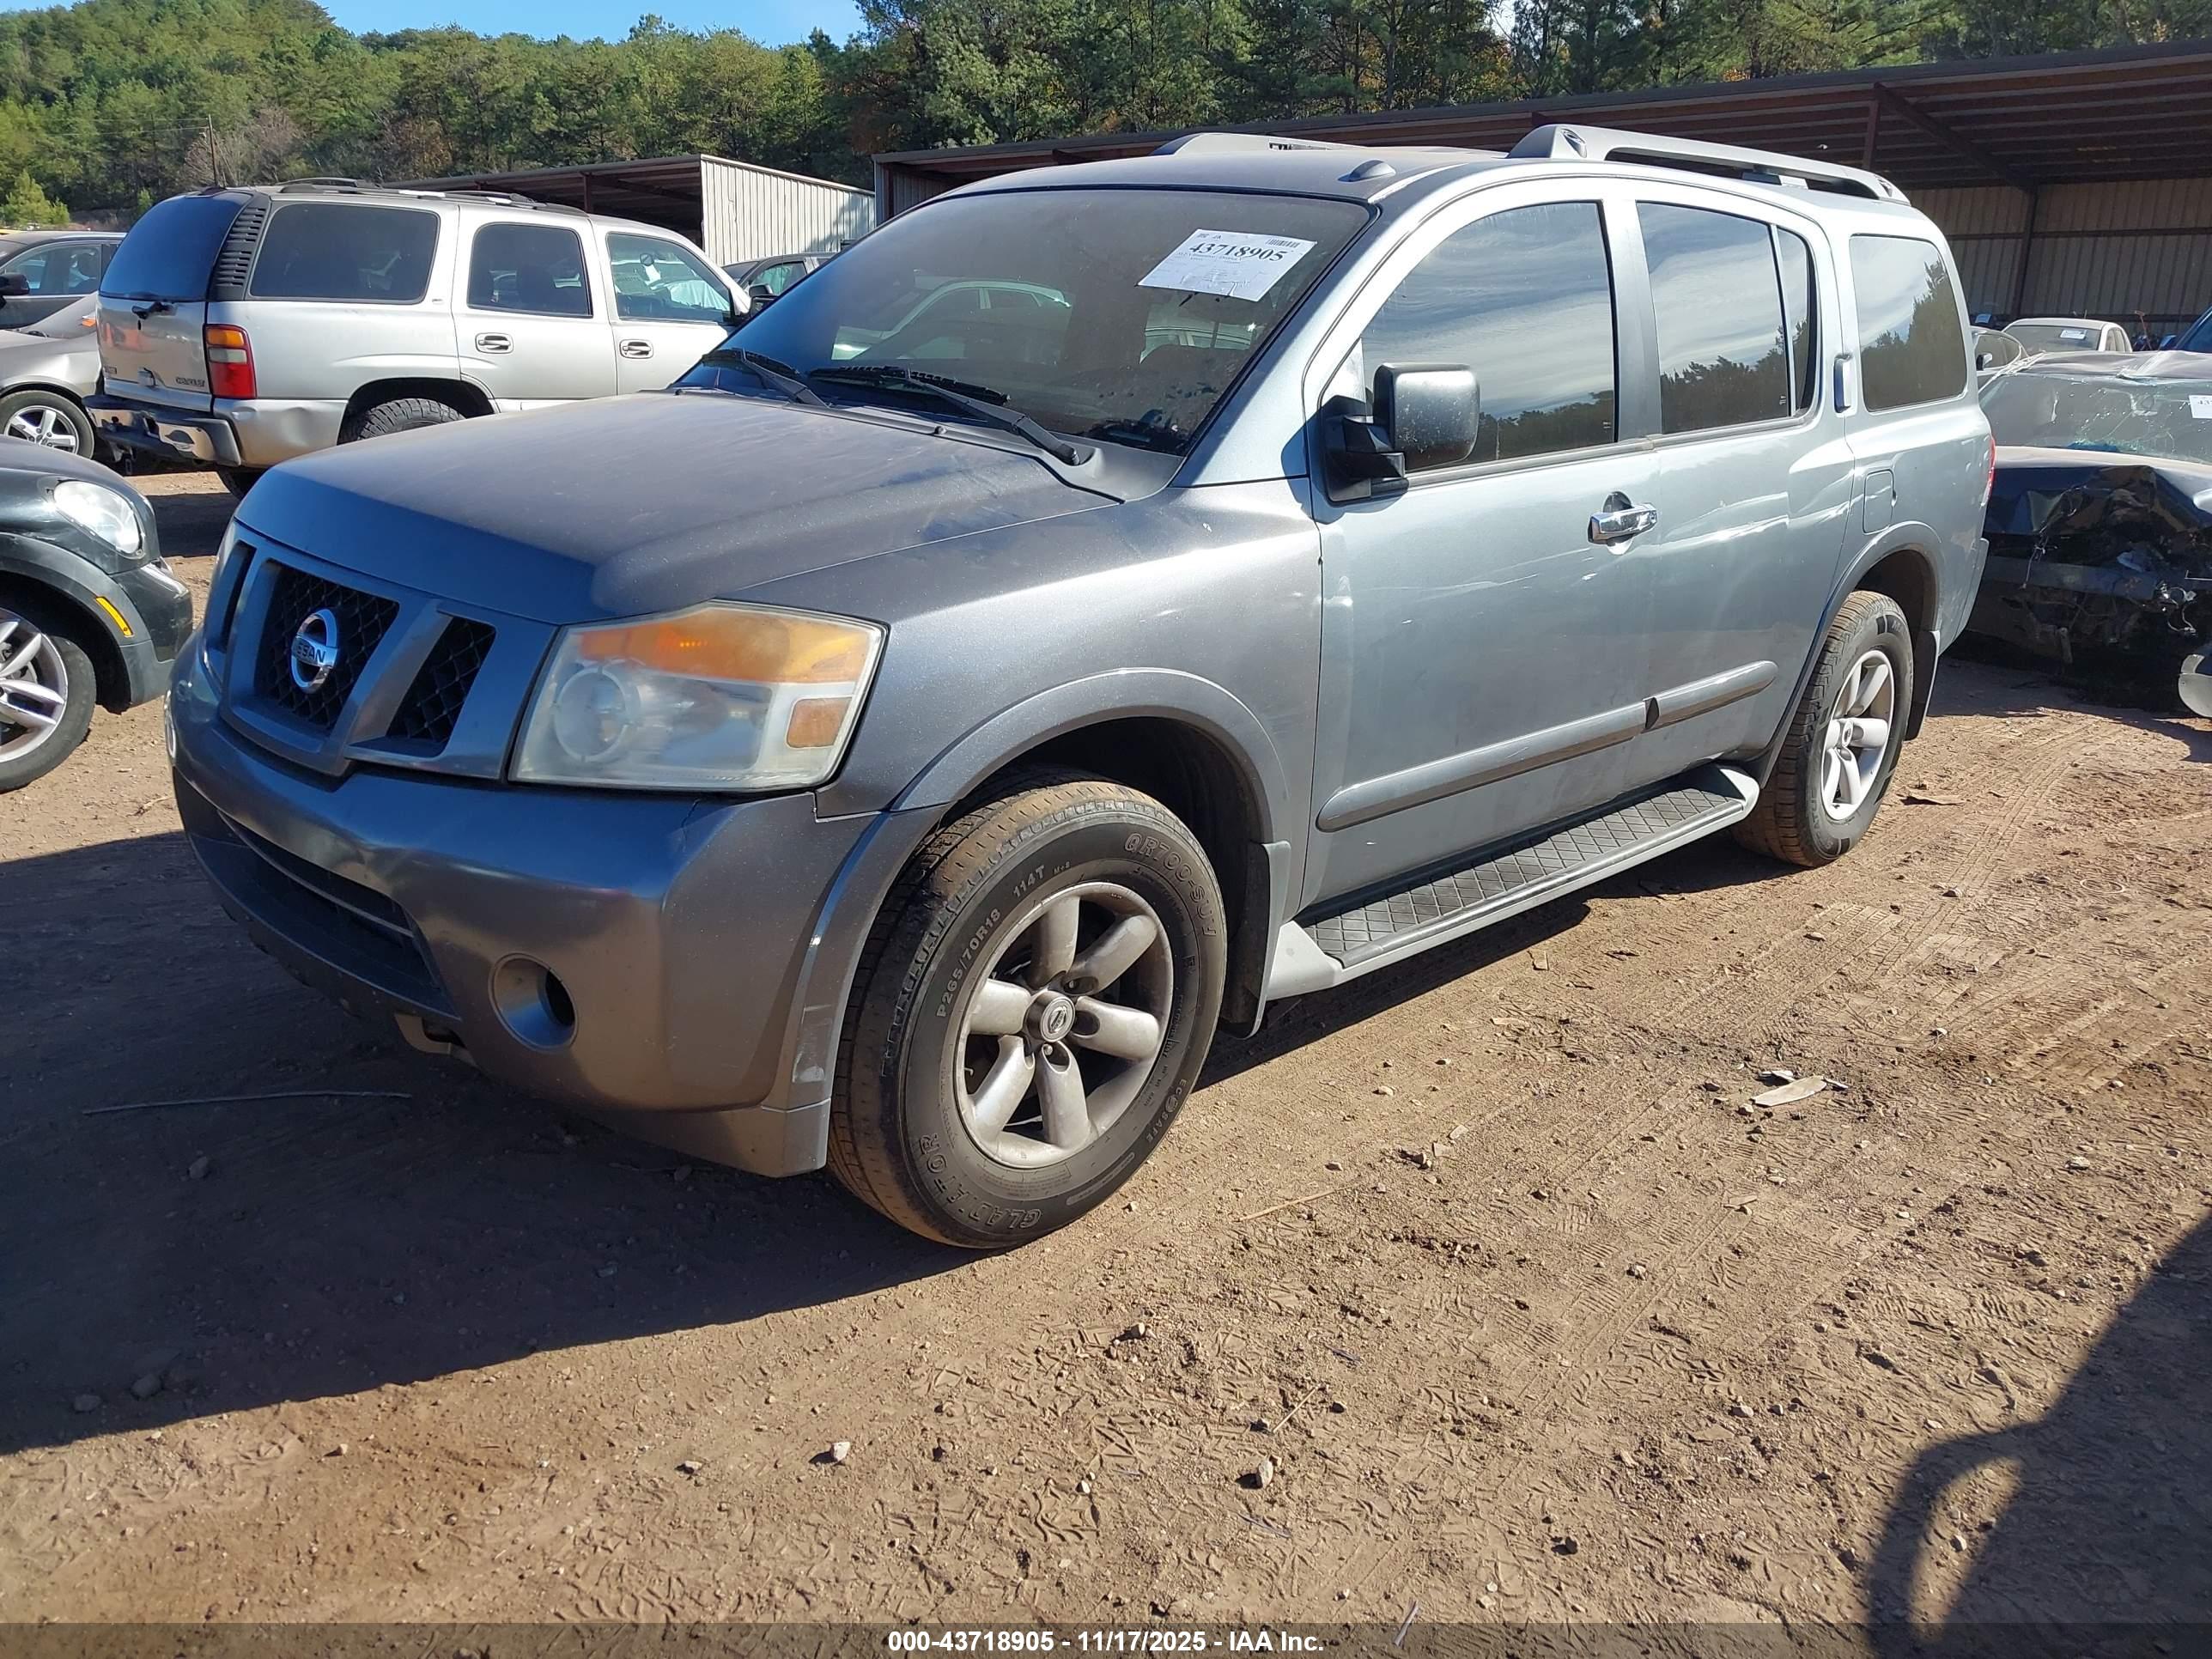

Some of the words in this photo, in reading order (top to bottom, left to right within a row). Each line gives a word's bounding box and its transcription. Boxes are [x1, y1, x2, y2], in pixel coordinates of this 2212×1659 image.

[1188, 242, 1287, 261] 43718905
[936, 908, 1002, 1018] P265/70R18
[1012, 865, 1045, 898] 114T
